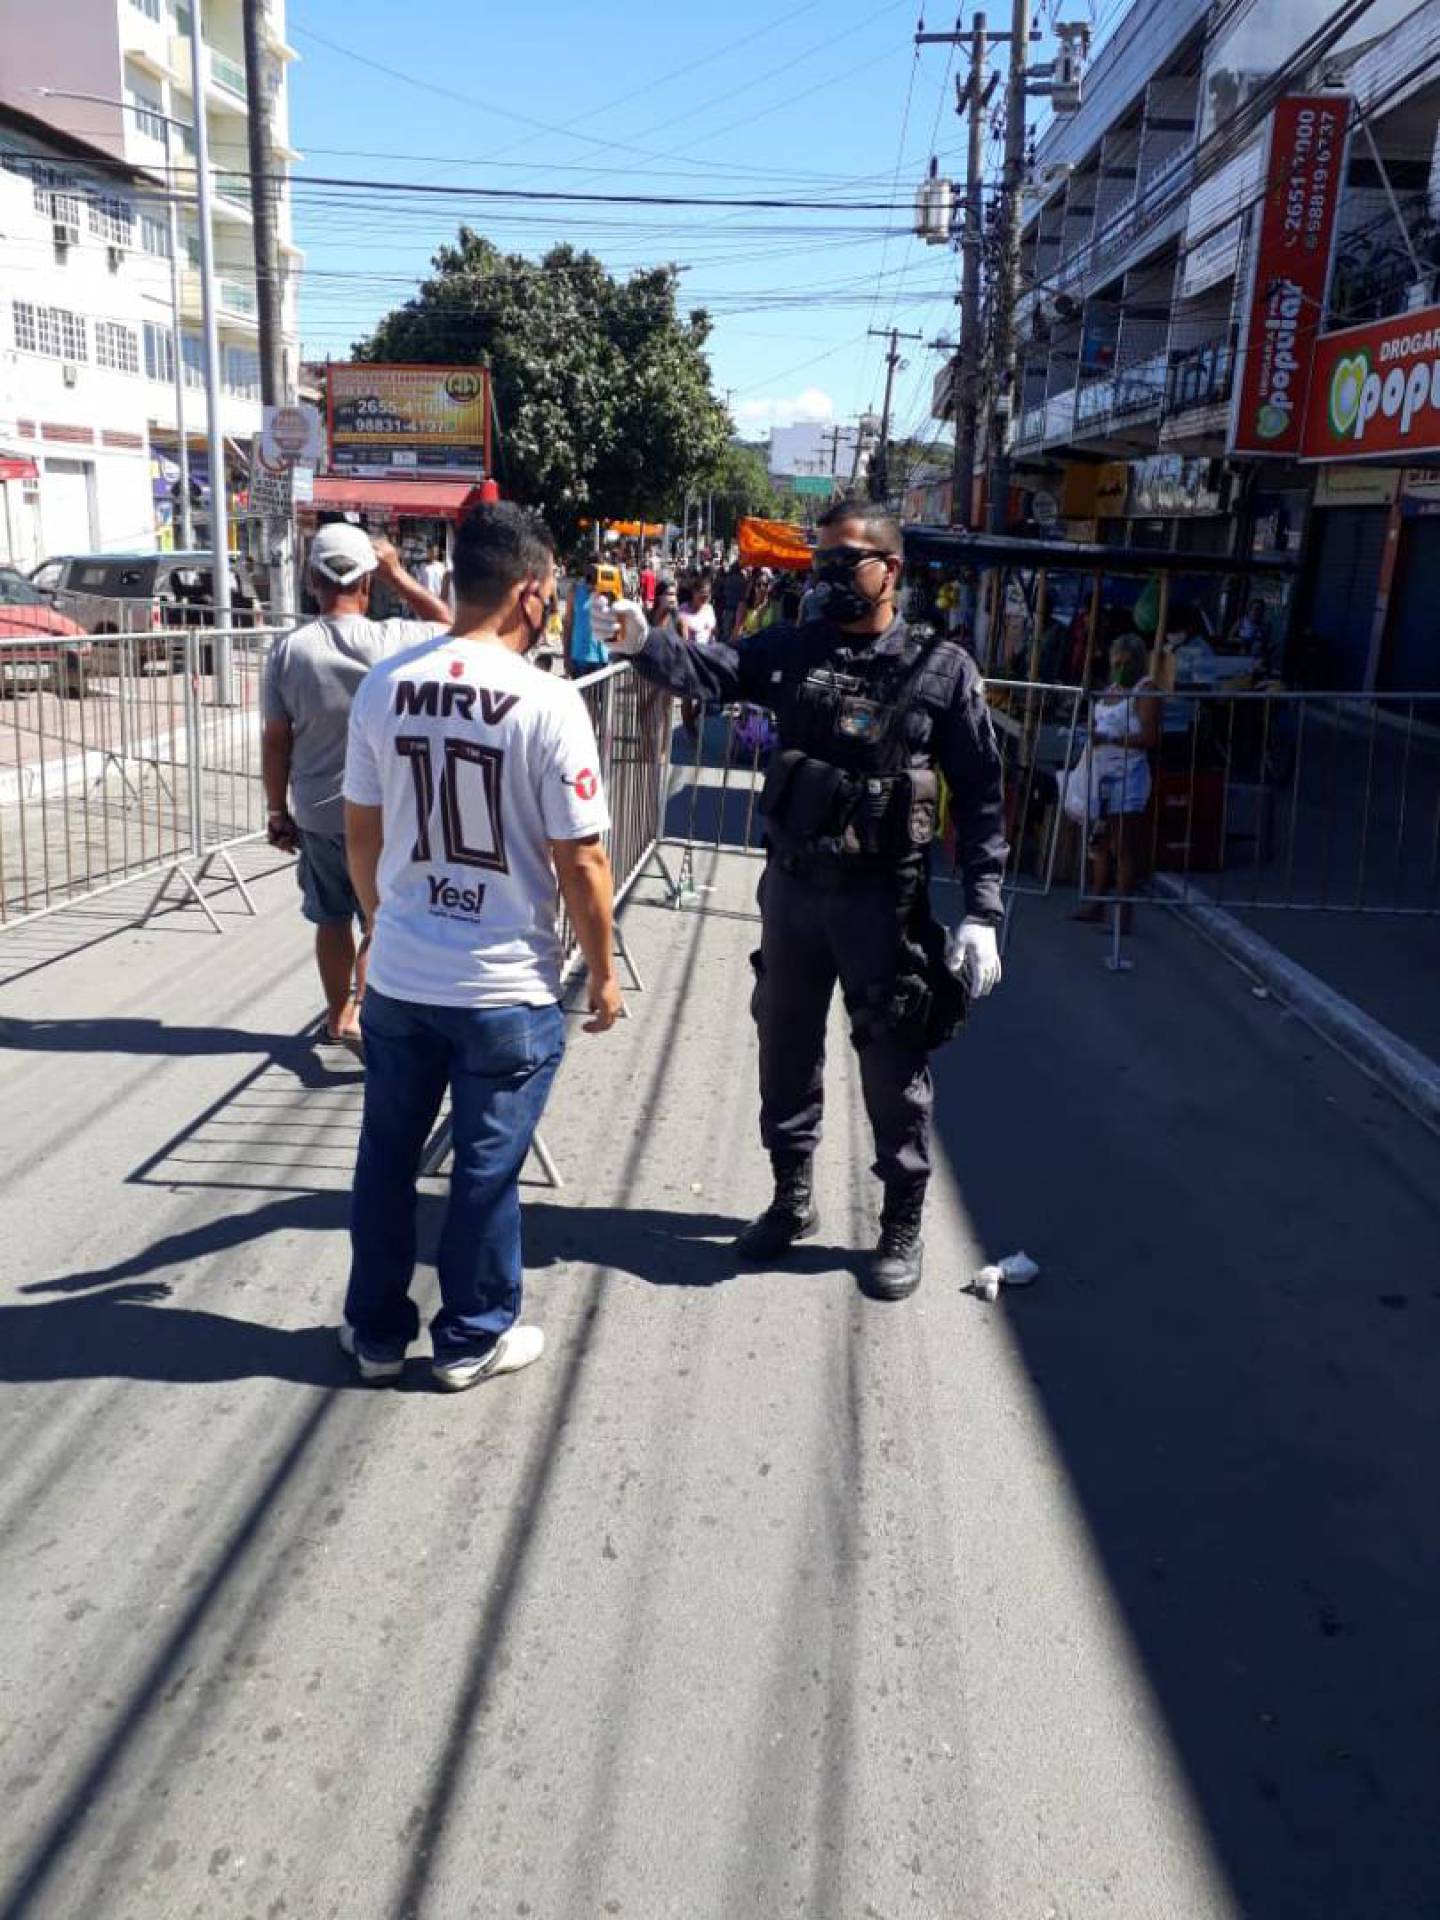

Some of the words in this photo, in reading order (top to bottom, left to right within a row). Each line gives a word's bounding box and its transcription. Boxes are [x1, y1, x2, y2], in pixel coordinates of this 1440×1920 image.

[395, 681, 520, 725] MRV
[394, 735, 509, 875] 10
[427, 875, 486, 914] Yes!
